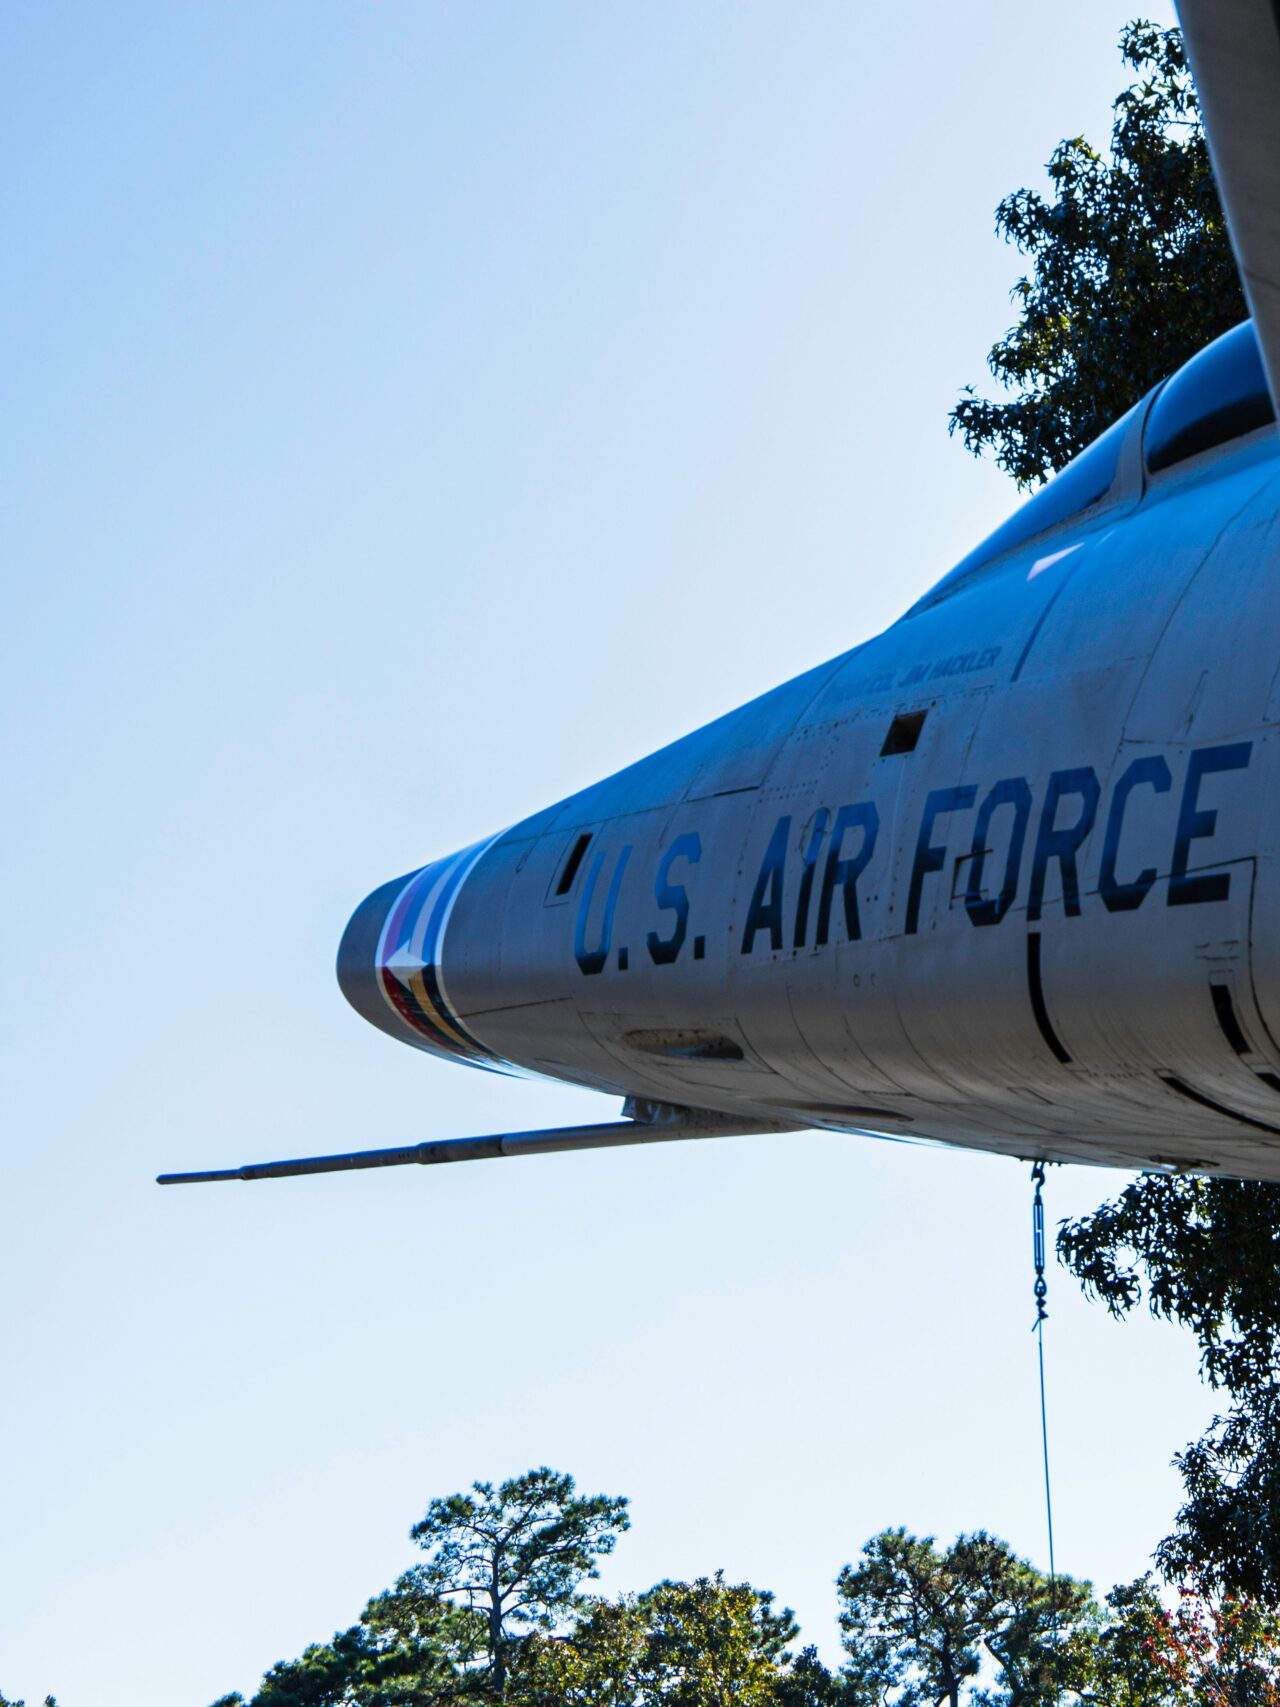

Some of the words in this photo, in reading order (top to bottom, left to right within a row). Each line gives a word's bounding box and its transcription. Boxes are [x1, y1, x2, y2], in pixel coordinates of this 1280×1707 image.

[929, 646, 1002, 680] HACKLER
[574, 832, 705, 975] U.S.
[741, 801, 880, 955] AIR
[904, 742, 1253, 935] FORCE
